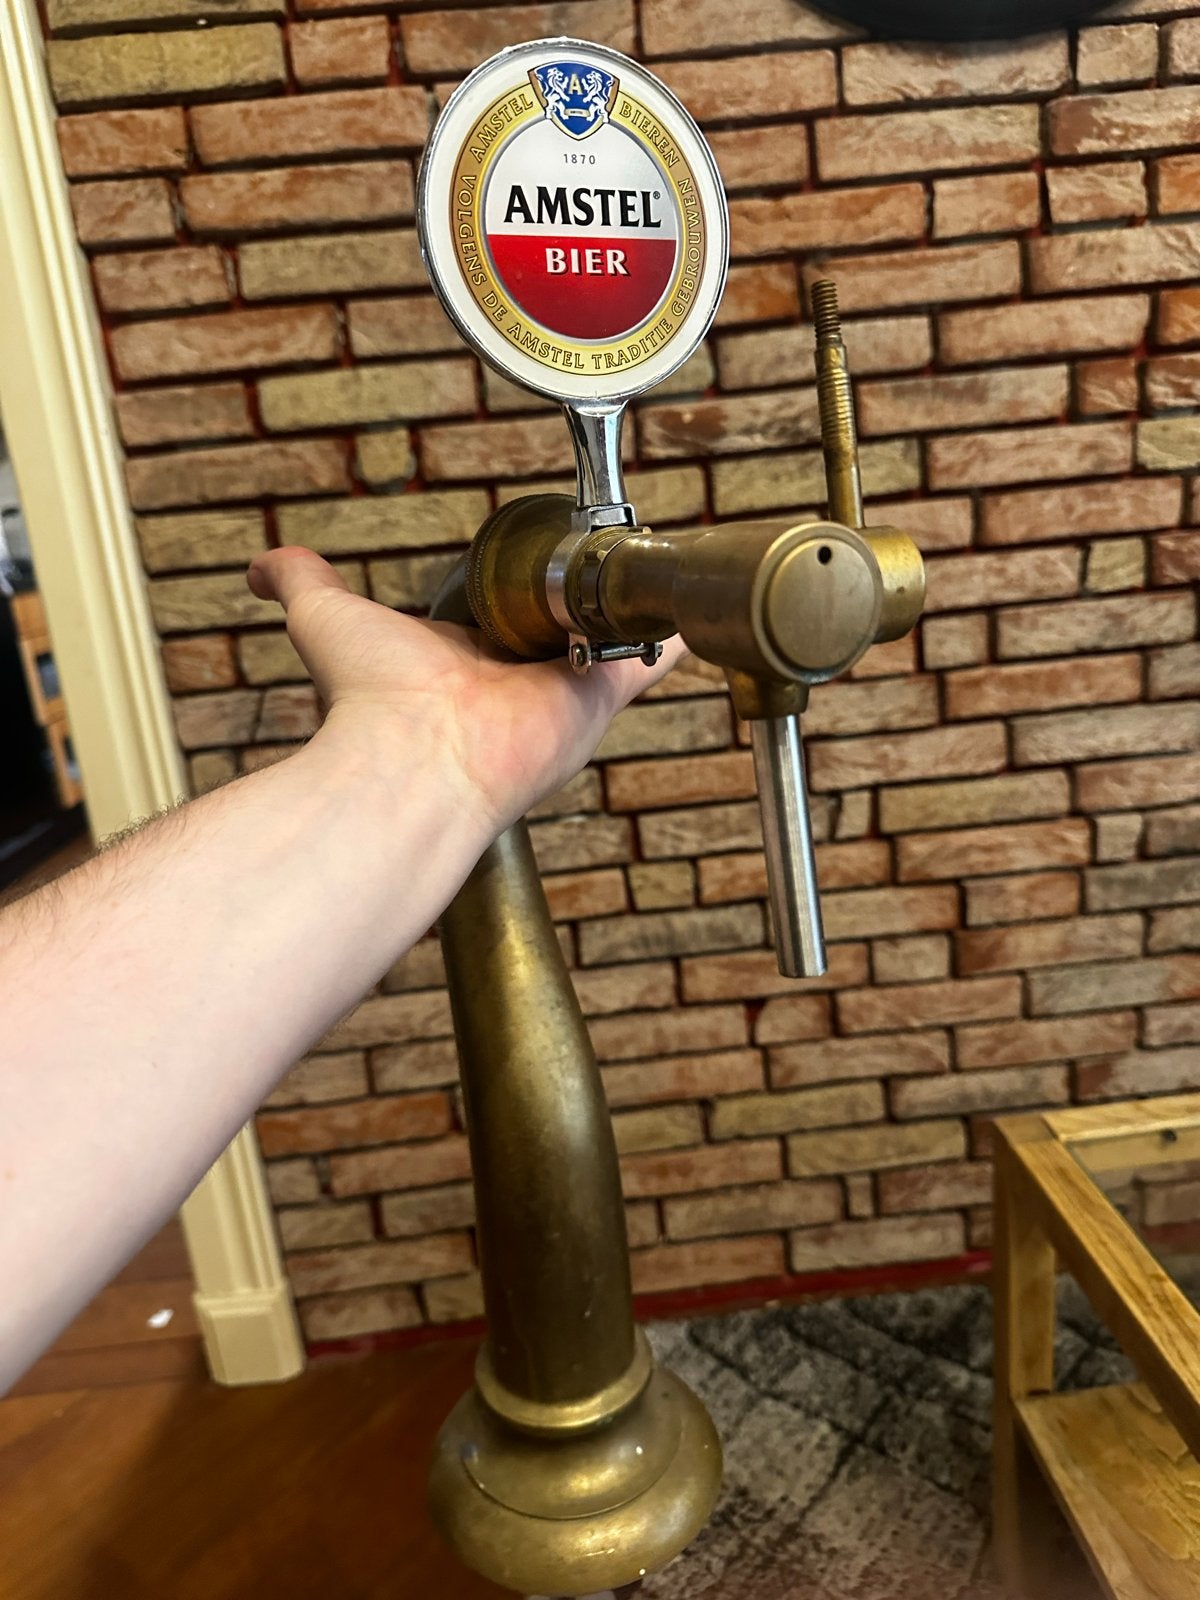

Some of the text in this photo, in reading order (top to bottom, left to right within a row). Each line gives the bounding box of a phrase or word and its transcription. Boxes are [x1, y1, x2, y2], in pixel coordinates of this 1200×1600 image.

[568, 73, 584, 96] A
[469, 93, 679, 168] AMSTEL BIEREN
[563, 153, 596, 165] 1870
[458, 175, 702, 370] VOLGENS DE AMSTEL TRADITIE GEBROUWEN
[545, 248, 629, 275] BIER
